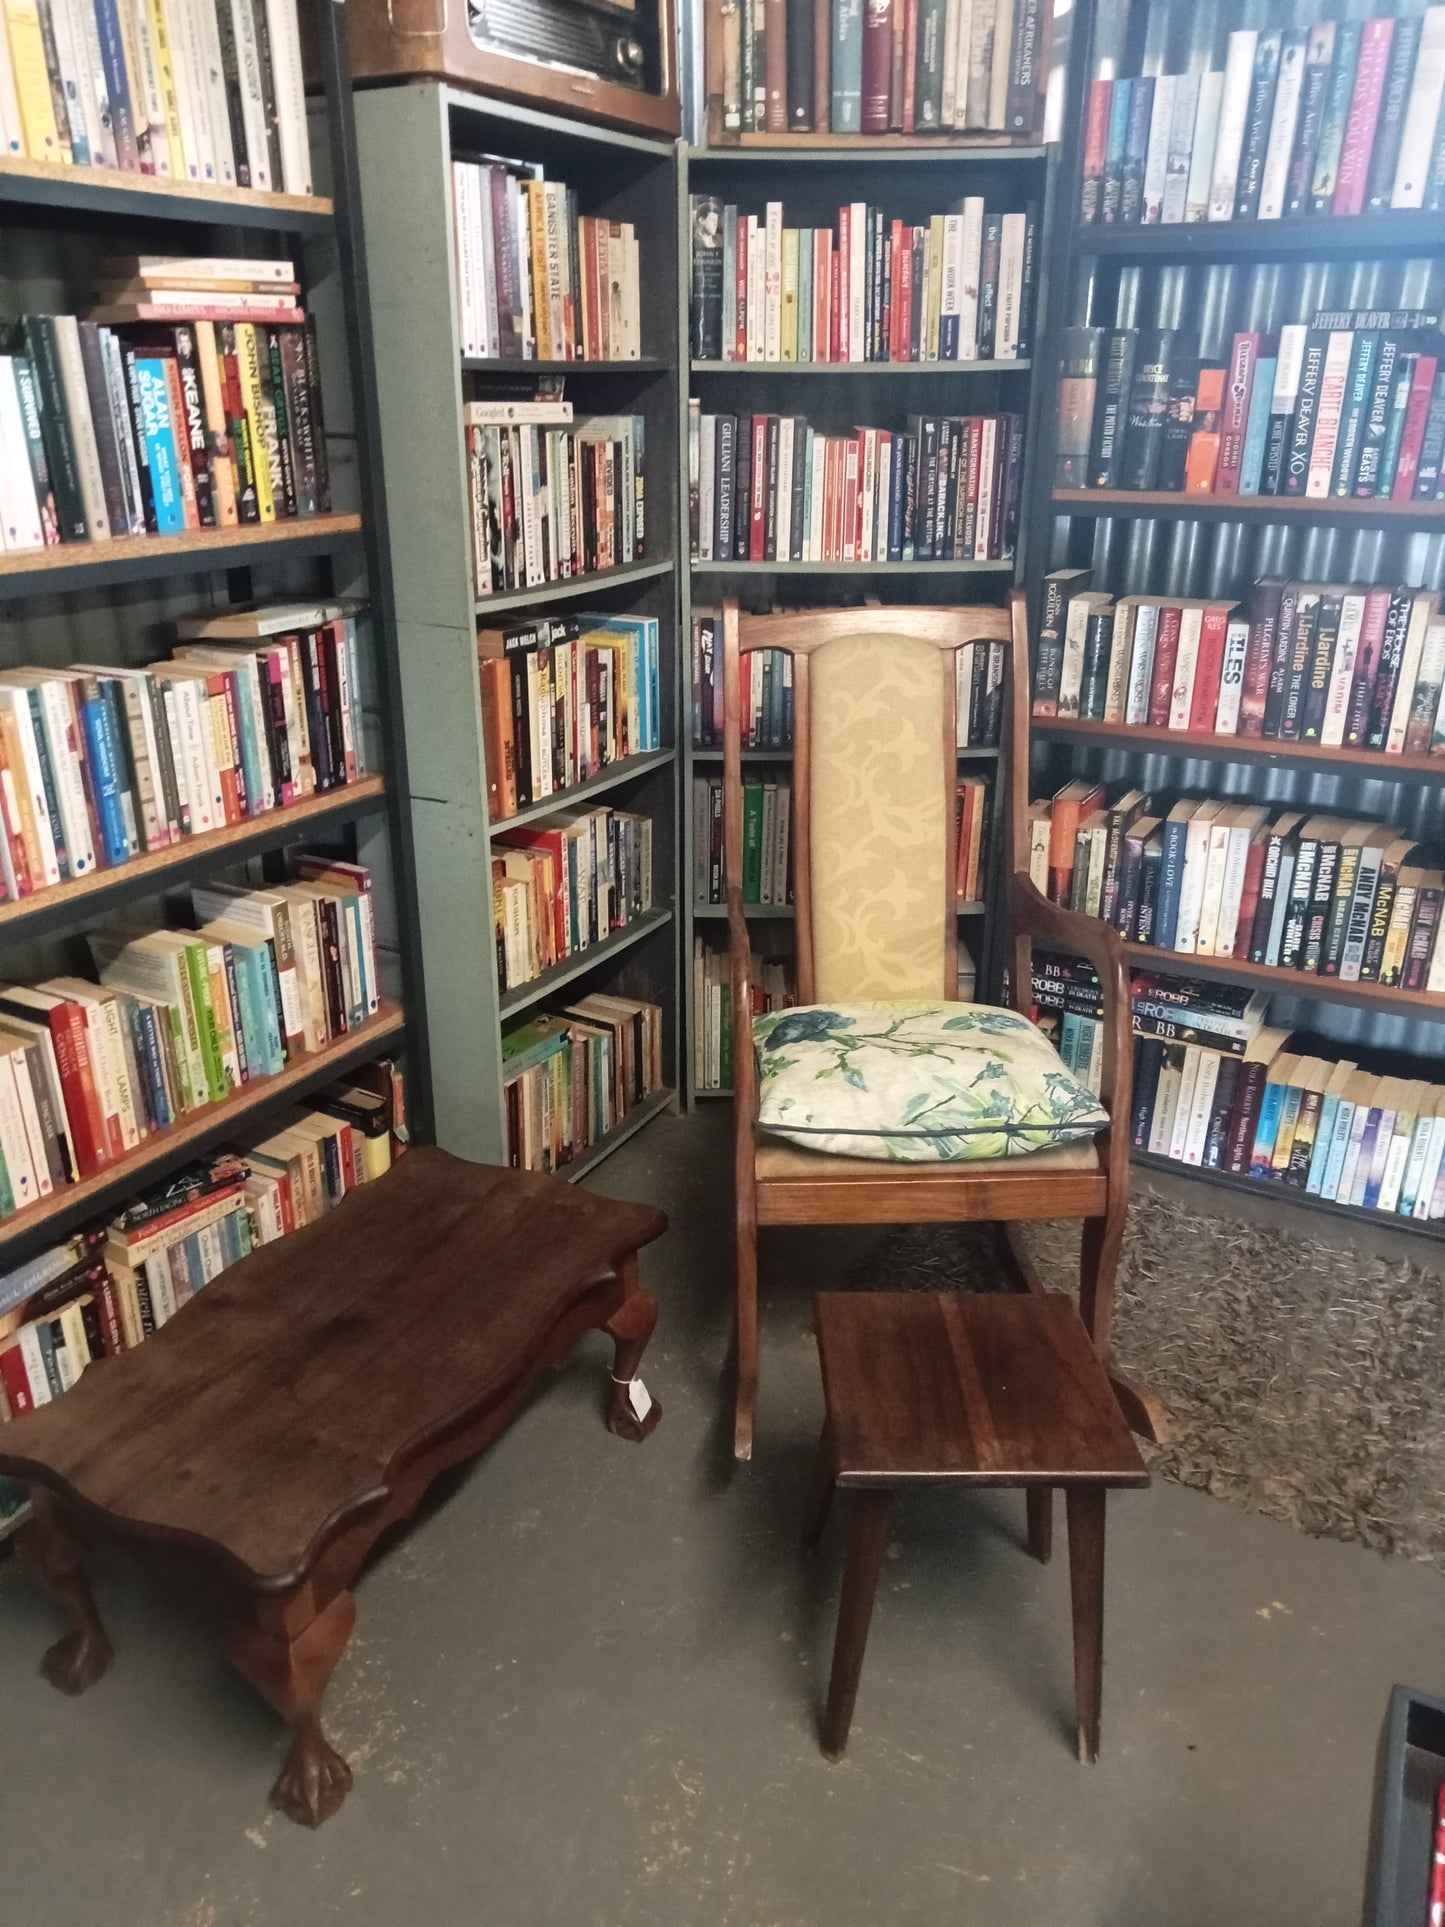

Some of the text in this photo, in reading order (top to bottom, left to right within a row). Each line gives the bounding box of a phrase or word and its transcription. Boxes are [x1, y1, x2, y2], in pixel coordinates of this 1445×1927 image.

[837, 5, 848, 41] Africa
[1020, 15, 1035, 86] AFRIKANERS
[1385, 27, 1415, 123] JEFFREY ARCHER
[1248, 80, 1269, 153] Jeffrey Archer
[1301, 72, 1323, 146] Jeffrey Archer
[1339, 41, 1376, 184] HEADS YOU WIN
[534, 193, 545, 233] AFRICA
[988, 226, 997, 241] the
[546, 193, 561, 300] GANGSTER STATE
[945, 220, 957, 311] THE WORK WEEK
[985, 284, 994, 307] effect
[1004, 313, 1012, 342] POPCORN
[244, 328, 266, 450] JOHN BISHOP
[270, 349, 282, 386] BEAR
[1370, 341, 1396, 422] JEFFERY DEAVER
[20, 377, 41, 439] SURVIVED
[137, 370, 158, 437] SUGAR
[151, 377, 170, 428] ALAN
[184, 378, 205, 450] KEANE
[1290, 348, 1321, 474] JEFFERY DEAVER XO
[1310, 376, 1344, 472] CARTE BLANCHE
[1340, 340, 1371, 481] JEFFERY DEAVER BROKEN WINDOW
[176, 415, 188, 462] FALLON
[182, 465, 194, 501] FORM
[263, 405, 283, 489] FRANK
[1267, 421, 1283, 471] MORE TWISTED
[1358, 447, 1373, 483] BEASTS
[636, 476, 644, 538] ZUMA EXPOSED
[720, 423, 731, 543] GIULIANI LEADERSHIP
[965, 428, 978, 545] TRANSFORMATION ED SILVOSO
[1045, 584, 1057, 627] IGGULDEN
[1397, 602, 1410, 626] THE
[506, 633, 536, 649] JACK WELCH
[551, 624, 566, 642] jack
[702, 630, 713, 654] PLAY
[1204, 638, 1216, 672] BLOOD
[1276, 598, 1294, 663] QUINTIN JARDINE
[1381, 609, 1398, 660] OF EROS
[1389, 629, 1406, 668] HOUSE
[991, 654, 1000, 688] BRANSON
[1223, 638, 1246, 685] ILES
[1255, 617, 1274, 695] PILGRIM'S WAR
[1270, 671, 1278, 689] CALL
[1276, 668, 1285, 693] ALARM
[1287, 619, 1312, 718] Jardine THE LONER
[1311, 632, 1334, 689] Jardine
[540, 673, 548, 736] Ramaphosa
[182, 691, 205, 808] About Time Adam Frank
[1112, 815, 1121, 826] VAL
[1165, 834, 1178, 888] BOOK LOVE
[1262, 846, 1282, 900] ORCHID BLUE
[1292, 850, 1316, 899] McNAB
[1336, 856, 1358, 897] McNAB
[1137, 905, 1147, 935] INTENT
[1309, 854, 1335, 940] McNAB CRISIS
[1348, 867, 1376, 944] ANDY McNAB
[1370, 886, 1392, 937] McNAB
[1392, 894, 1416, 929] McNAB
[1283, 919, 1297, 955] WINTER
[1292, 924, 1303, 952] DARK
[104, 1004, 118, 1036] LIGHT
[1155, 990, 1189, 1006] ROBB
[55, 1033, 70, 1078] GENIUS
[206, 1010, 219, 1053] YOUR CHILD
[1081, 1025, 1094, 1040] NORA
[97, 1055, 109, 1085] Order
[104, 1089, 113, 1112] Book
[116, 1074, 131, 1113] LAMPS
[1237, 1064, 1260, 1142] NORA Northern
[1139, 1106, 1148, 1120] High
[1341, 1107, 1350, 1120] NORA
[1290, 1148, 1303, 1171] VILLA
[1299, 1154, 1308, 1169] THE
[202, 1235, 212, 1260] Choke
